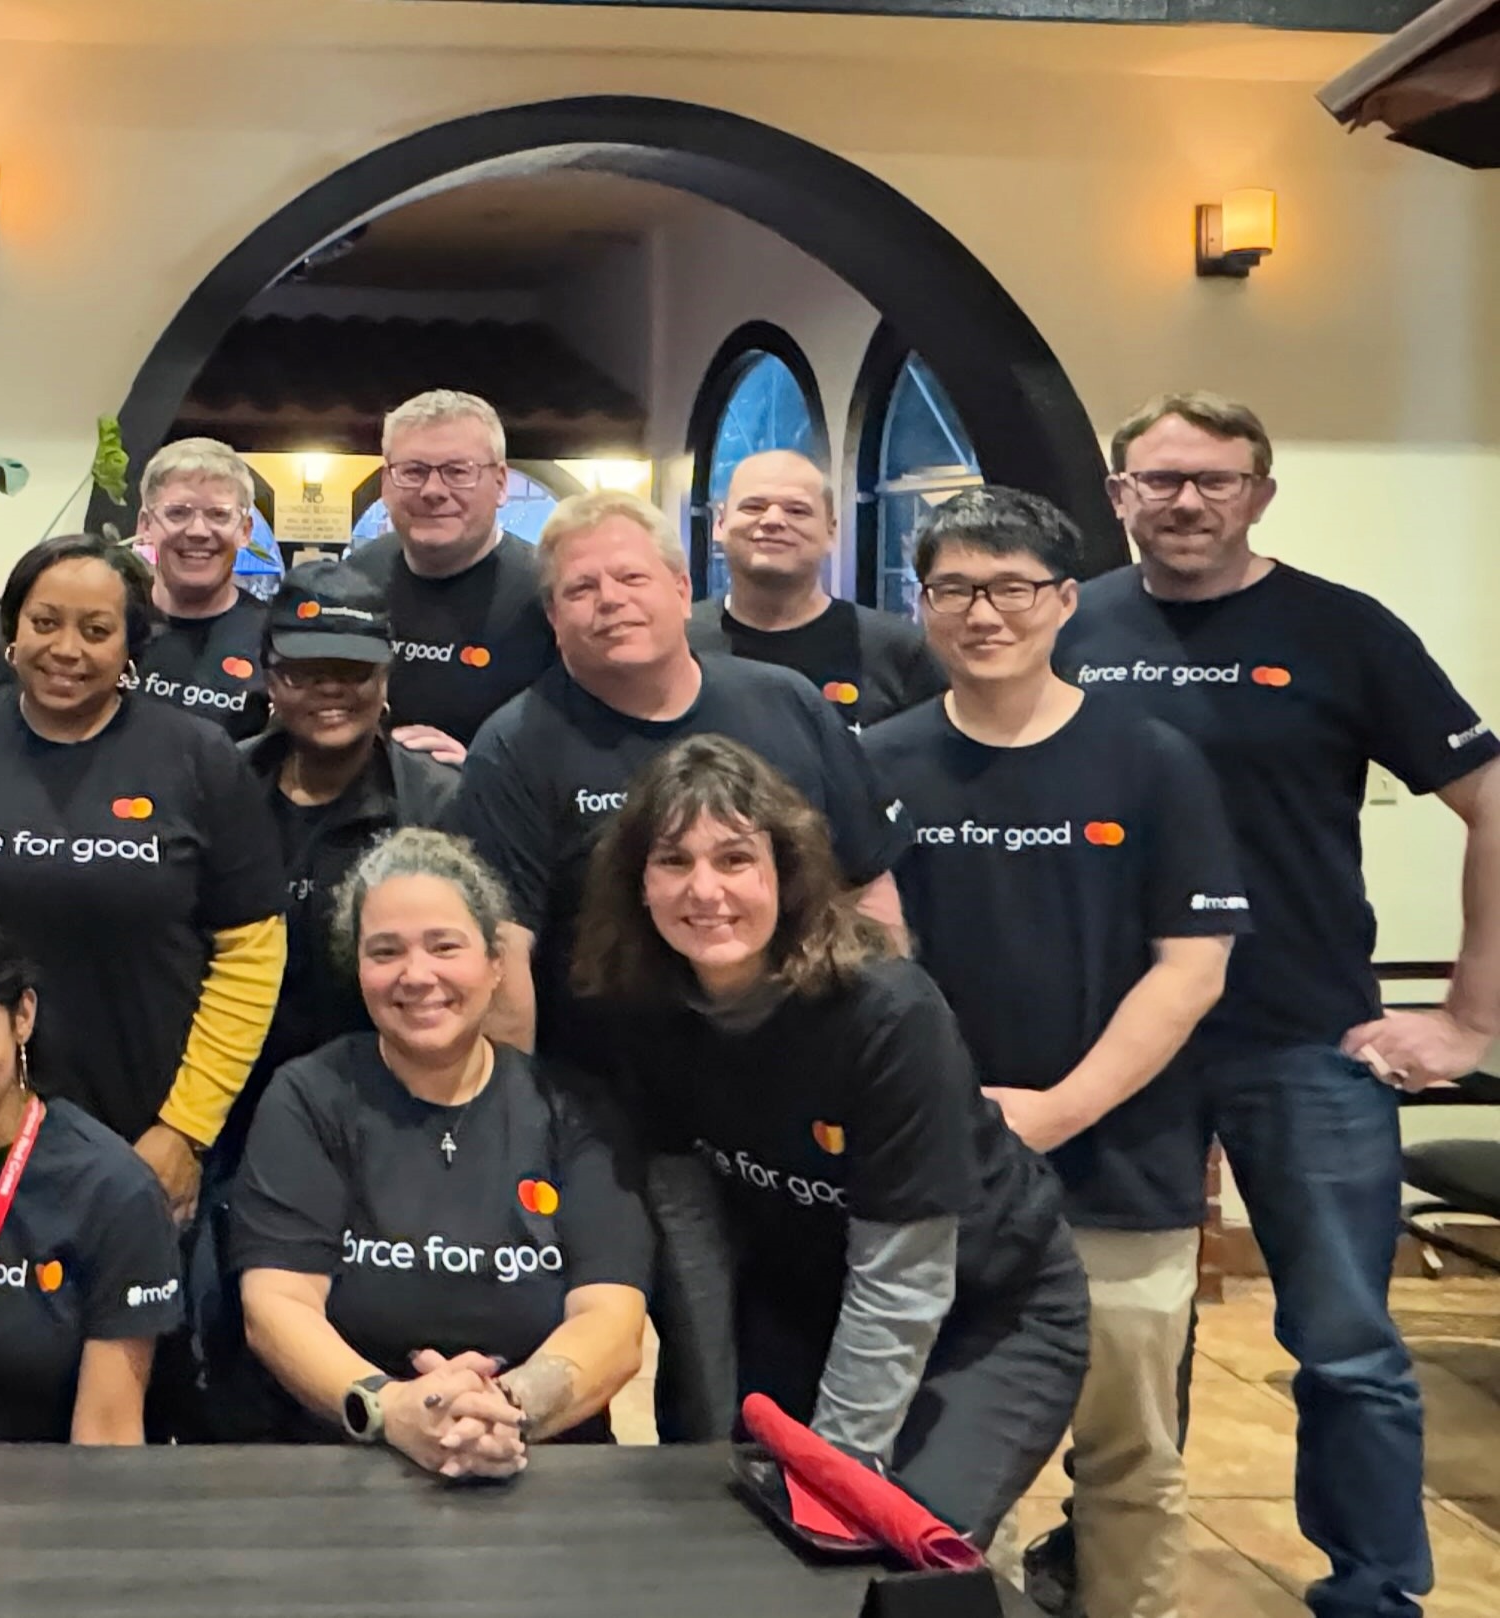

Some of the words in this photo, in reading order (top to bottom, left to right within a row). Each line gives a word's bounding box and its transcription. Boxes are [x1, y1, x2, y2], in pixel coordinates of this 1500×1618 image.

[404, 642, 455, 662] good
[1077, 664, 1128, 684] force
[1132, 660, 1169, 682] for
[1172, 662, 1240, 686] good
[144, 672, 181, 698] for
[182, 690, 248, 713] good
[13, 831, 64, 856] for
[71, 835, 160, 864] good
[915, 826, 956, 844] rce
[959, 820, 1000, 844] for
[1004, 820, 1072, 851] good
[735, 1151, 779, 1190] for
[423, 1236, 485, 1273] for
[494, 1245, 563, 1283] goo
